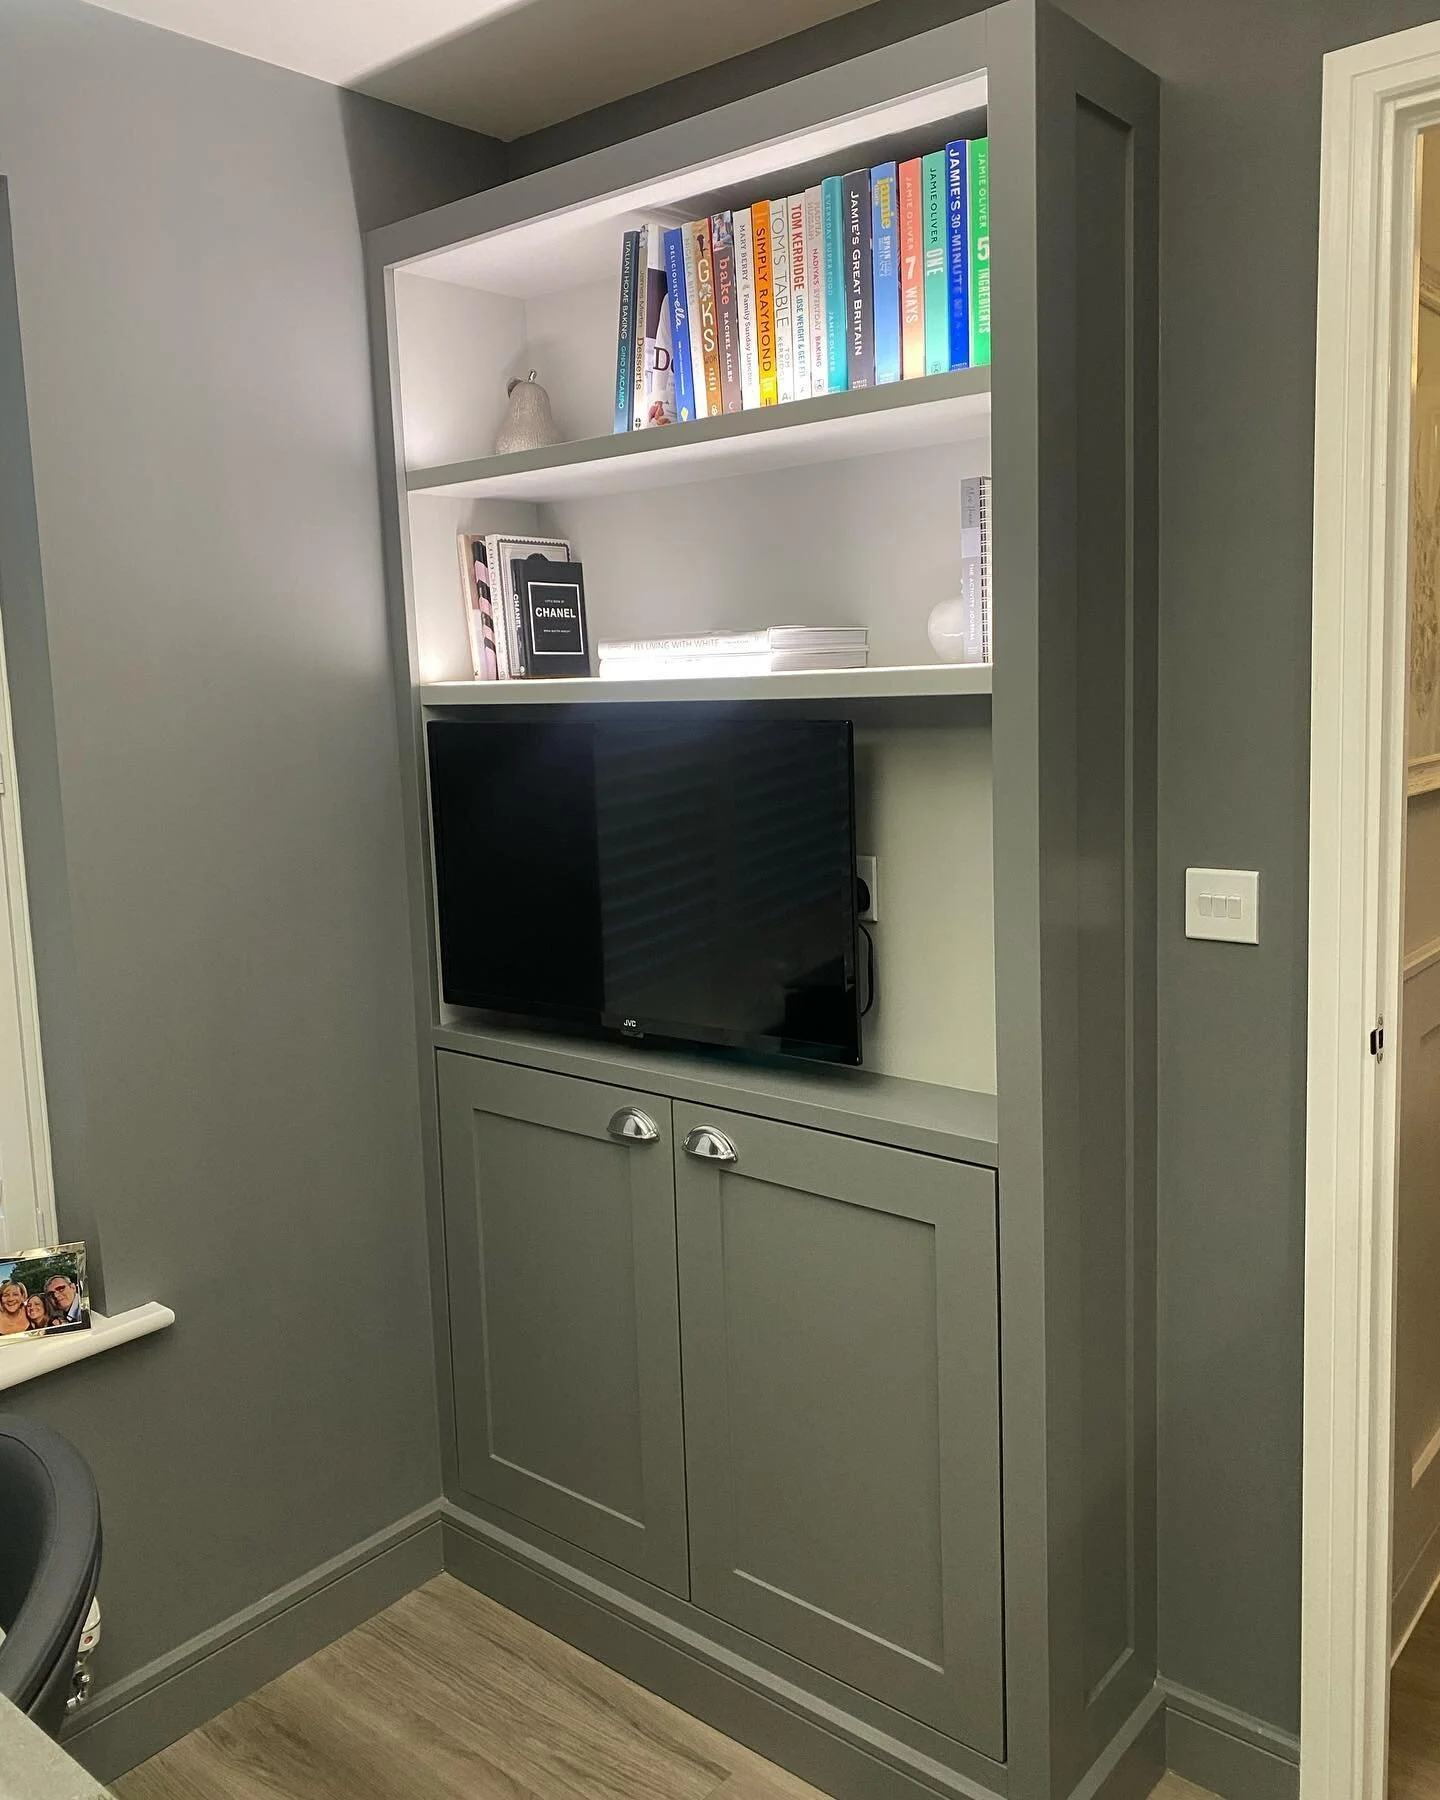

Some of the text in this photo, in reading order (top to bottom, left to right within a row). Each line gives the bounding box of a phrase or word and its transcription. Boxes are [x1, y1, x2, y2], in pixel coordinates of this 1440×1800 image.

[878, 177, 894, 229] jamie
[929, 168, 938, 244] JAMIE OLIVER
[949, 149, 961, 211] JAMIE'S
[978, 152, 987, 229] JAMIE OLIVER
[825, 194, 833, 240] EVERYDAY
[905, 176, 914, 250] JAMIE OLIVER
[669, 245, 679, 297] DELICIOUSLY
[739, 225, 749, 280] MARY BERRY
[771, 205, 789, 328] TOM'S TABLE
[791, 203, 805, 290] TOM KERRIDGE
[850, 190, 863, 356] JAMIE'S GREAT BRITAIN
[883, 235, 891, 260] SPAIN
[926, 248, 944, 276] ONE
[951, 213, 963, 293] 30-MINUTE
[620, 240, 632, 339] ITALIAN HOME BAKING
[719, 255, 731, 305] bake
[756, 227, 772, 372] SIMPLY RAYMOND
[796, 295, 804, 312] LOSE
[905, 255, 918, 324] 7 WAYS
[977, 236, 990, 334] 5 INGREDIENTS
[742, 293, 751, 321] Family
[797, 314, 805, 343] WEIGHT
[813, 288, 821, 331] EVERYDAY
[618, 345, 627, 409] GINO D'ACAMPO
[635, 336, 645, 391] Desserts
[725, 351, 734, 383] ALLEN
[513, 593, 521, 631] CHANEL
[535, 607, 576, 618] CHANEL
[671, 640, 692, 649] WITH
[693, 638, 720, 648] WHITE
[623, 1019, 637, 1028] JVC
